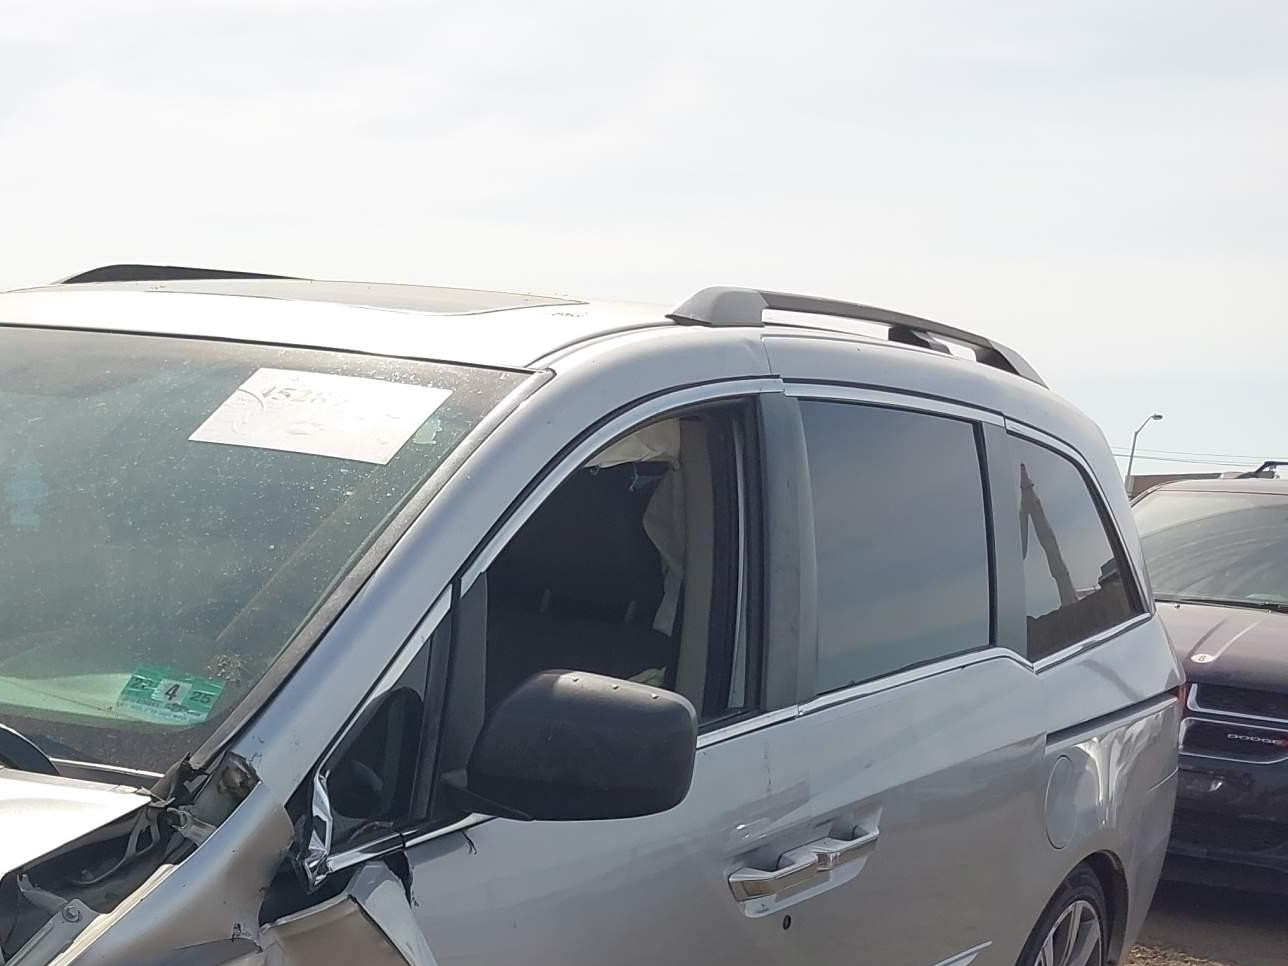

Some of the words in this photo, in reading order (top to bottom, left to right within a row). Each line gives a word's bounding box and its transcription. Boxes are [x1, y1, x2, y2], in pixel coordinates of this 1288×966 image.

[164, 683, 180, 701] 4
[190, 691, 212, 704] 25
[1227, 733, 1283, 745] DODGE
